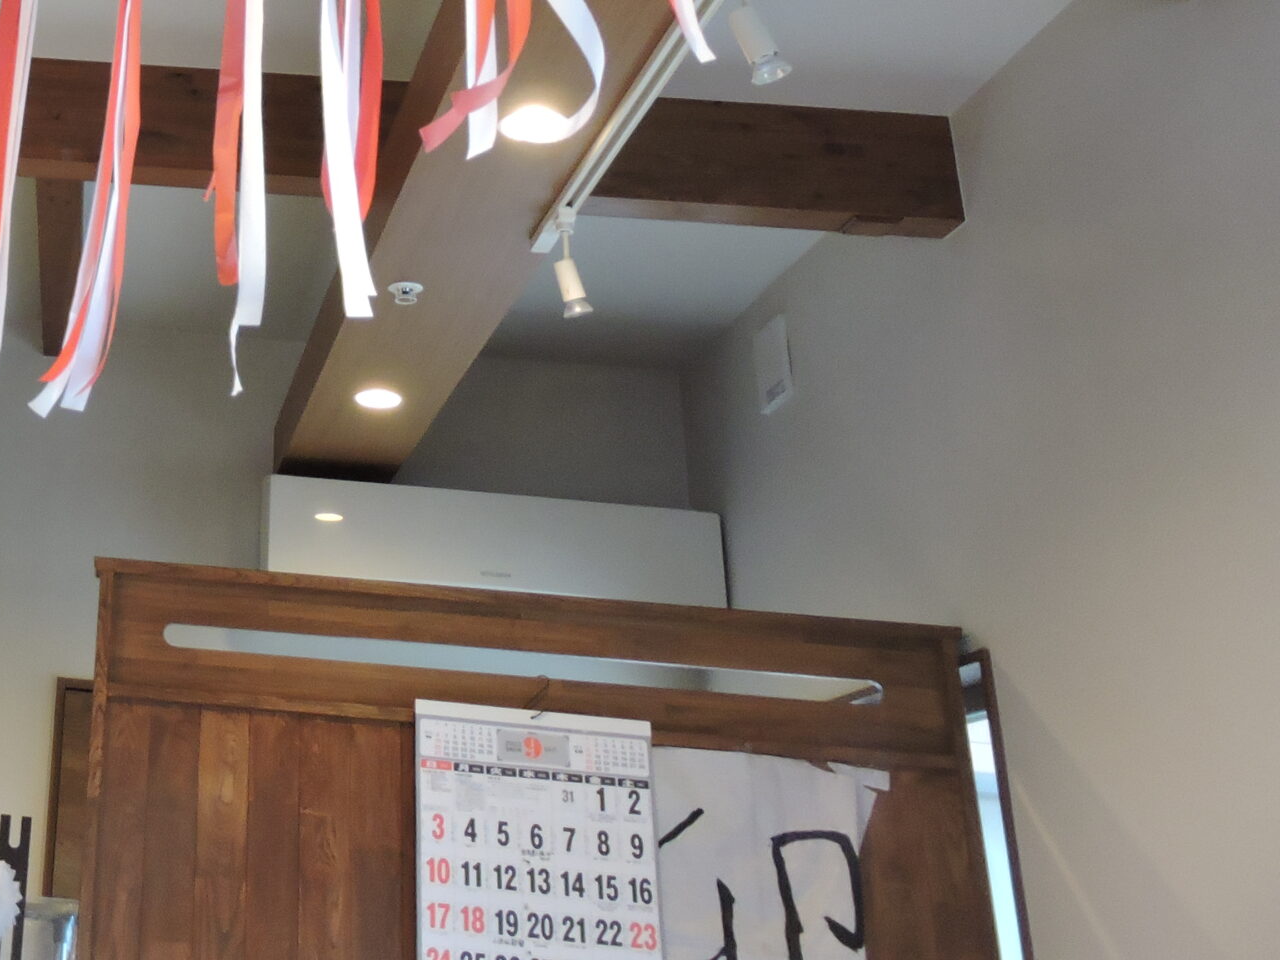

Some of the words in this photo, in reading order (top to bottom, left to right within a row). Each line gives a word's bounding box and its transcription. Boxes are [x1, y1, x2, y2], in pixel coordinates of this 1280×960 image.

[561, 789, 575, 804] 31
[596, 787, 606, 812] 1
[628, 789, 642, 816] 2
[431, 813, 445, 840] 3
[463, 817, 477, 843] 4
[497, 820, 510, 847] 5
[530, 823, 544, 850] 6
[562, 826, 576, 853] 7
[597, 830, 611, 857] 8
[630, 833, 644, 860] 9
[426, 857, 451, 885] 10
[461, 861, 482, 888] 11
[493, 864, 518, 892] 12
[526, 867, 551, 895] 13
[560, 871, 586, 898] 14
[594, 874, 619, 902] 15
[628, 877, 653, 905] 16
[426, 902, 451, 929] 17
[460, 905, 485, 934] 18
[494, 909, 519, 937] 19
[526, 912, 554, 941] 20
[562, 915, 586, 944] 21
[595, 918, 623, 947] 22
[629, 922, 658, 951] 23
